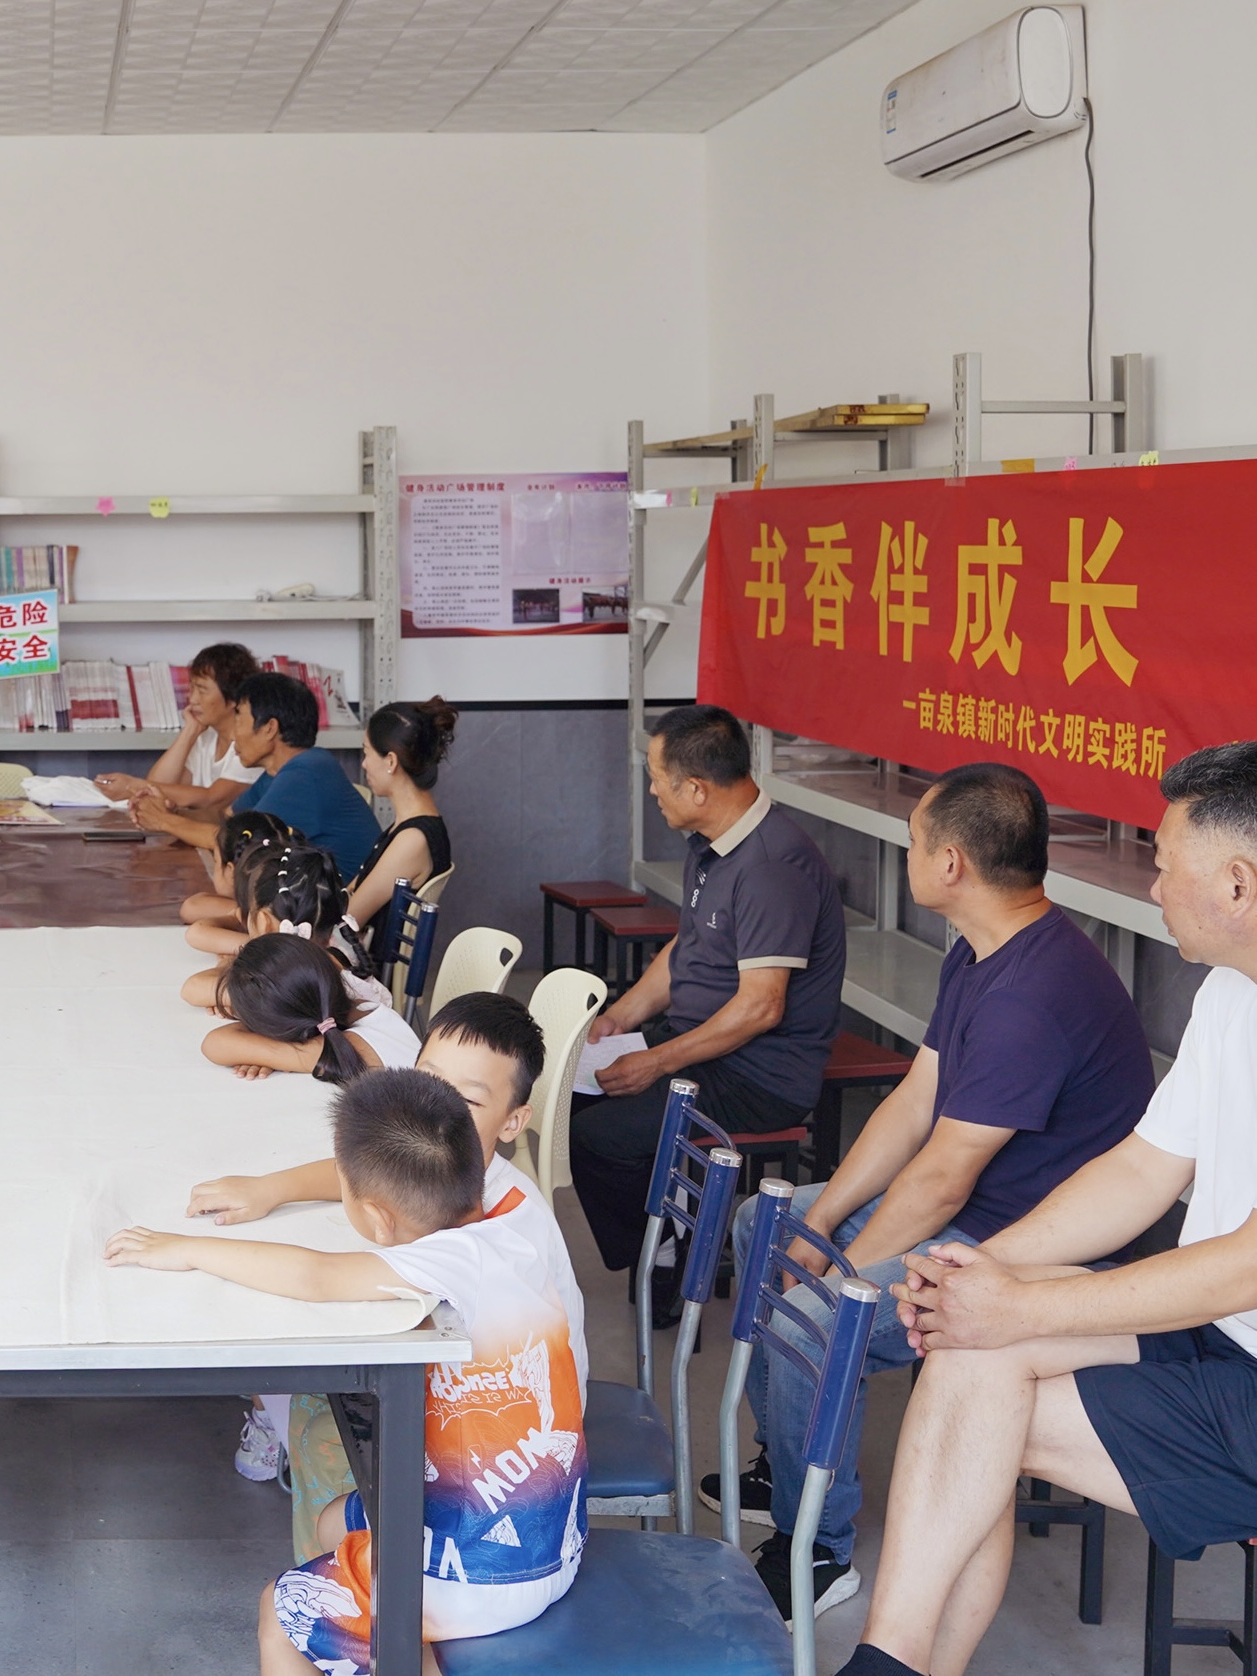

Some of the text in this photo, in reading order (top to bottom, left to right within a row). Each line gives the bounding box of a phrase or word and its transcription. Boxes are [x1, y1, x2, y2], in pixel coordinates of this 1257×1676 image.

[744, 516, 1140, 688] 书香伴成长
[902, 687, 1168, 781] 一亩泉镇新时代文明实践所
